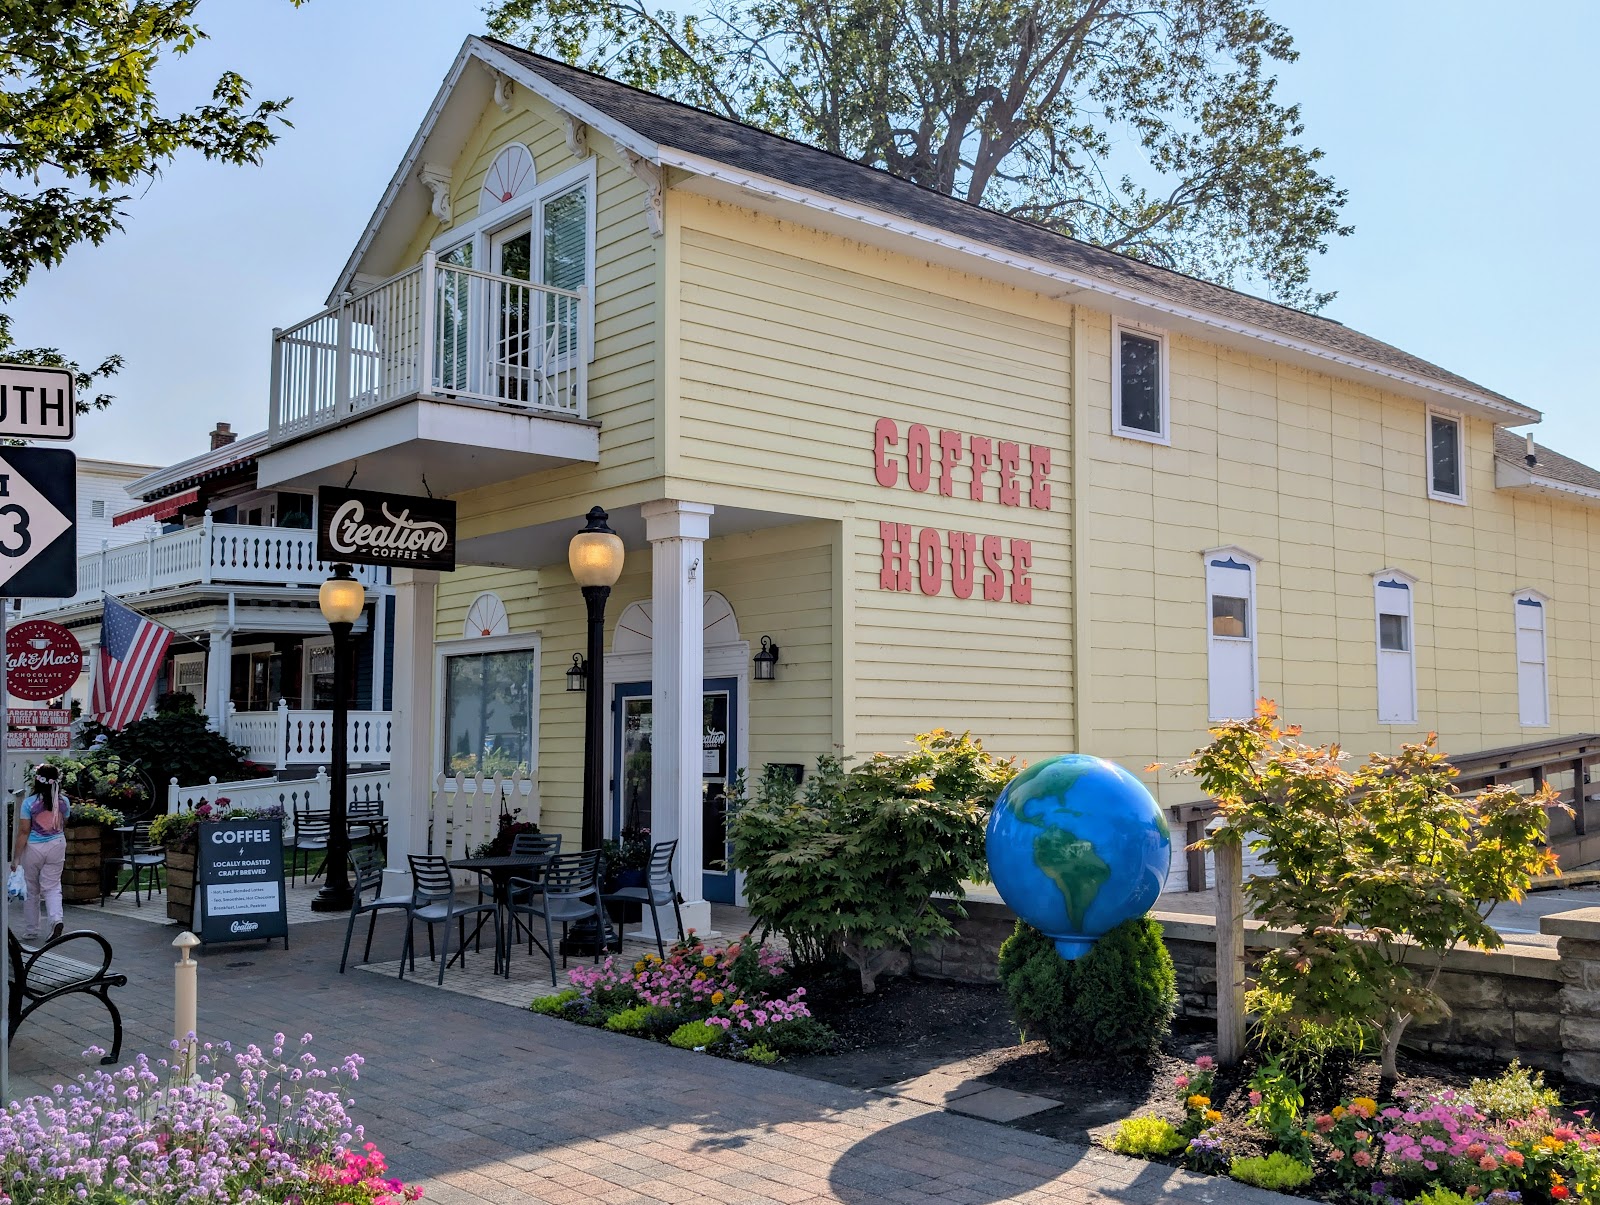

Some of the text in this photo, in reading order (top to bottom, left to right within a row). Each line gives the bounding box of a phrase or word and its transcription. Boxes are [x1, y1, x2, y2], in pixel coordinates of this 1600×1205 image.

[0, 385, 64, 426] TH
[873, 417, 1051, 510] COFFEE
[0, 504, 32, 557] 3
[329, 500, 448, 553] Creation
[371, 548, 418, 560] COFFEE
[880, 521, 1032, 604] HOUSE
[13, 716, 31, 724] TOFFEE
[7, 738, 24, 747] UDGE
[31, 738, 68, 747] CHOCOLATES
[211, 829, 271, 844] COFFEE
[213, 859, 271, 868] LOCALLY ROASTED
[230, 920, 259, 933] Creation
